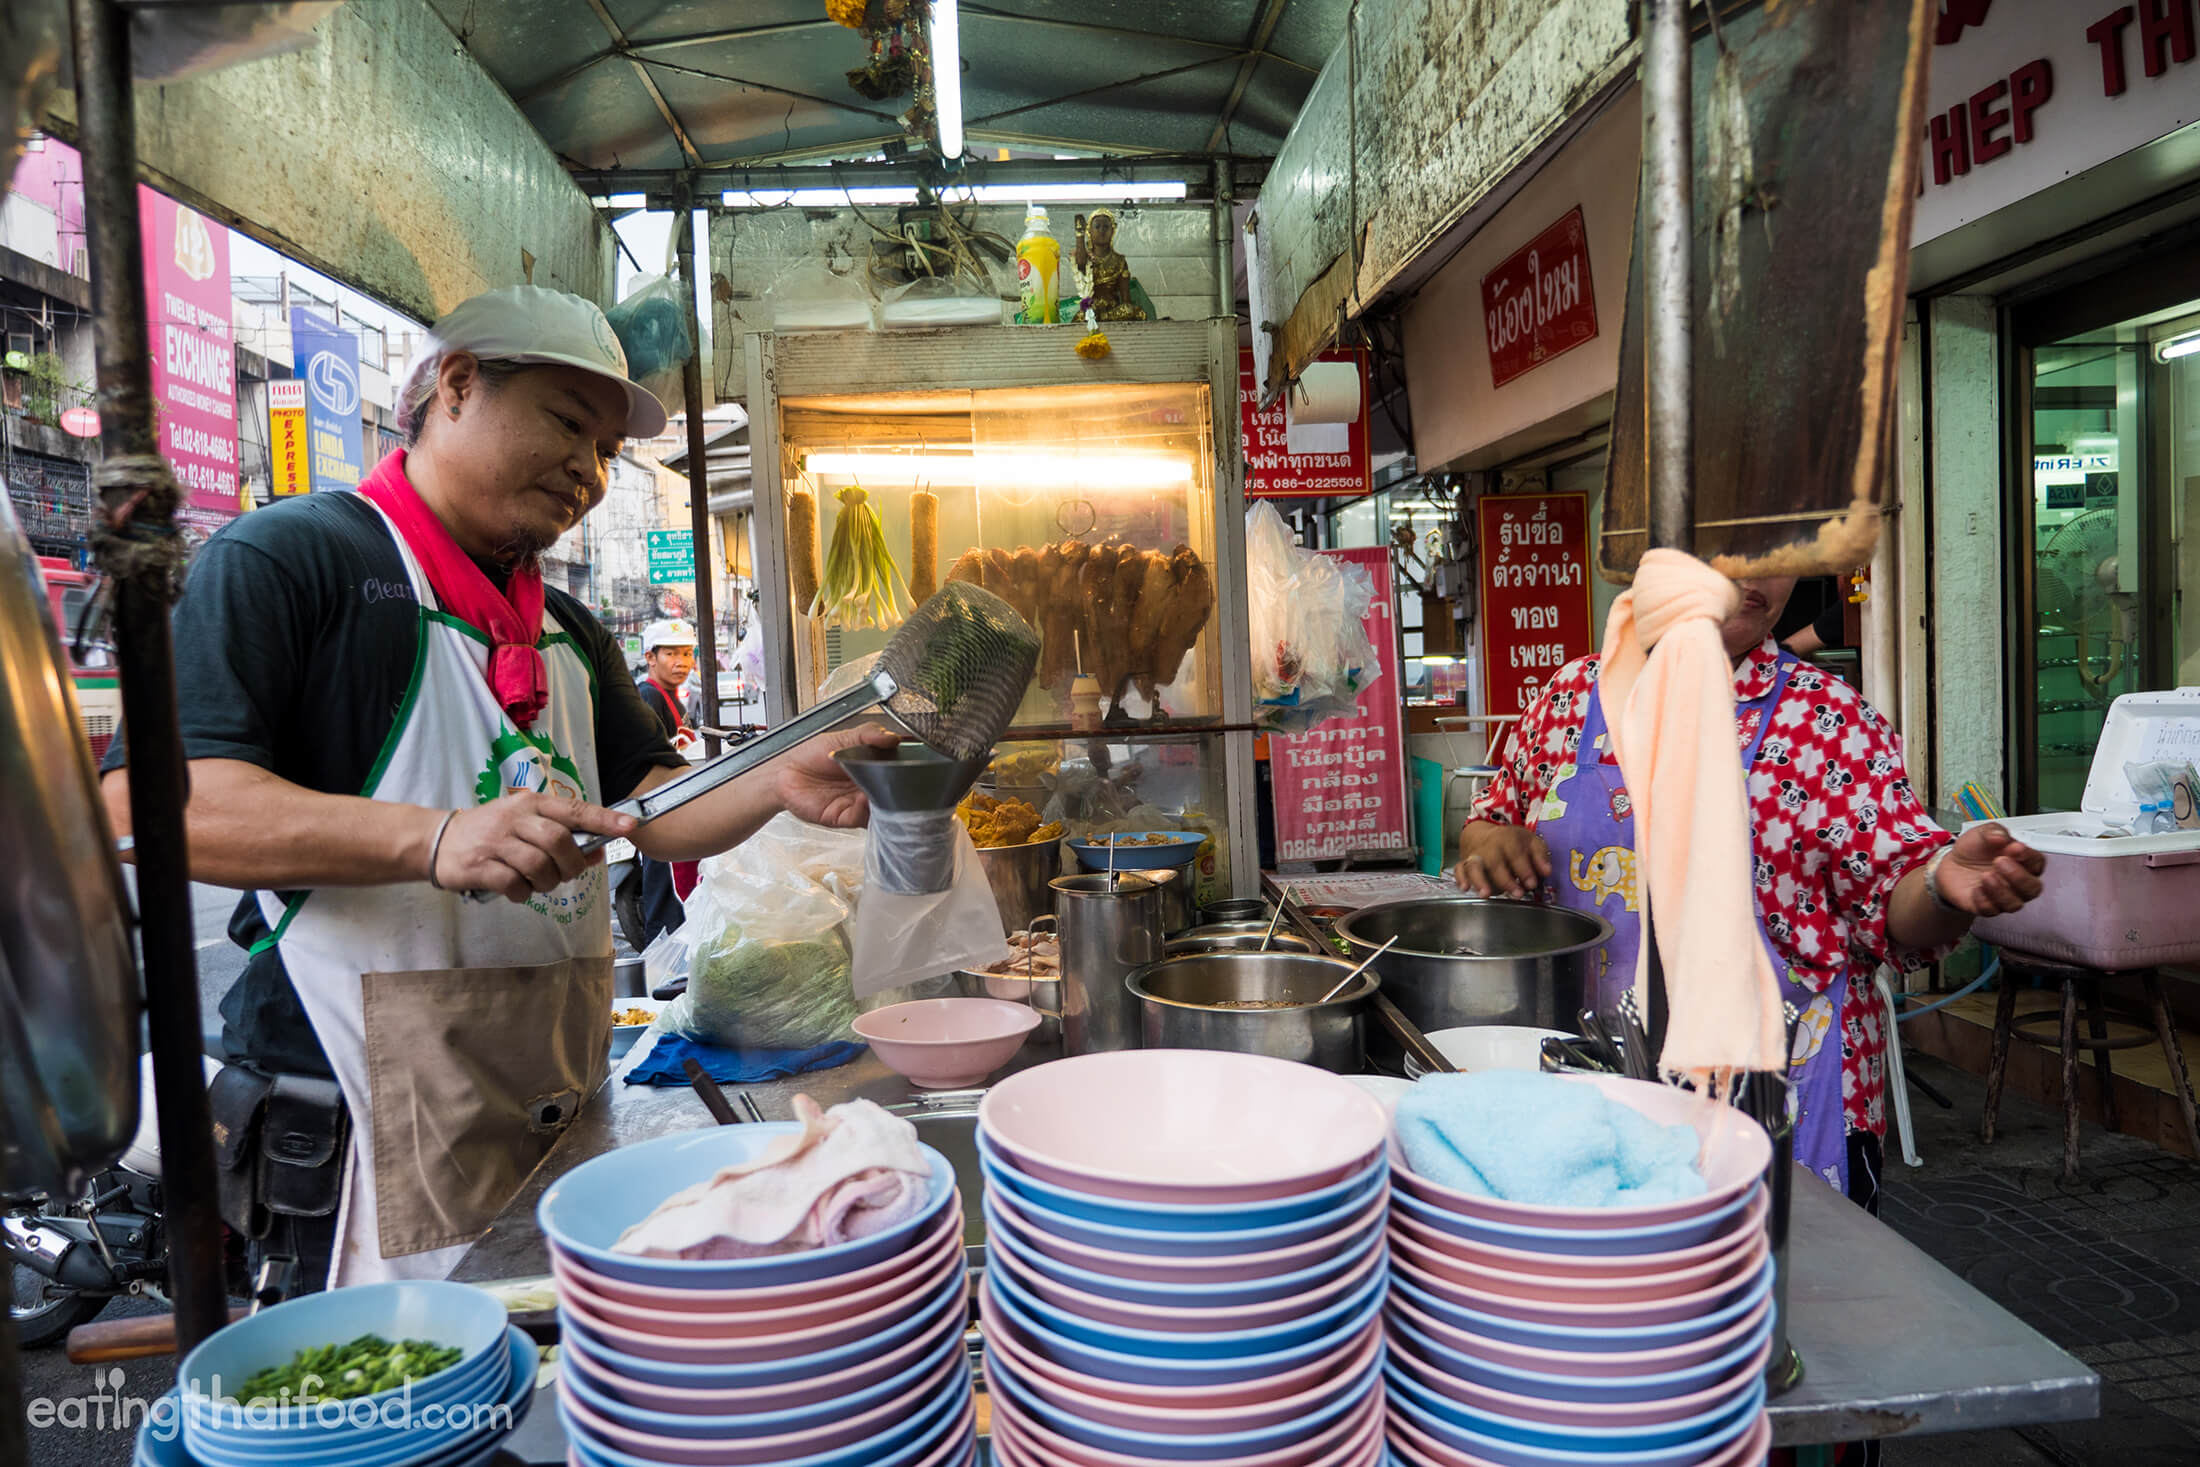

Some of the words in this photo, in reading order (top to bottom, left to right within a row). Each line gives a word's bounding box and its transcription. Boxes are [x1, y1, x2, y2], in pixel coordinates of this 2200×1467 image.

[1919, 58, 2053, 197] HEP
[2086, 0, 2200, 97] TH
[165, 291, 196, 326] TWELVE
[166, 323, 231, 396] EXCHANGE
[272, 409, 304, 417] PHOTO
[1251, 406, 1286, 425] เหล้
[284, 419, 296, 494] EXPRESS
[316, 455, 360, 486] EXCHANGE
[1272, 476, 1363, 488] 086-0225506
[1499, 501, 1563, 546] รับซื้อ
[1493, 547, 1581, 587] ตั๋วจำนำ
[1511, 605, 1559, 630] ทอง
[1510, 643, 1564, 668] เพชร
[1302, 770, 1379, 790] กล้อง
[1303, 792, 1382, 814] มือถือ
